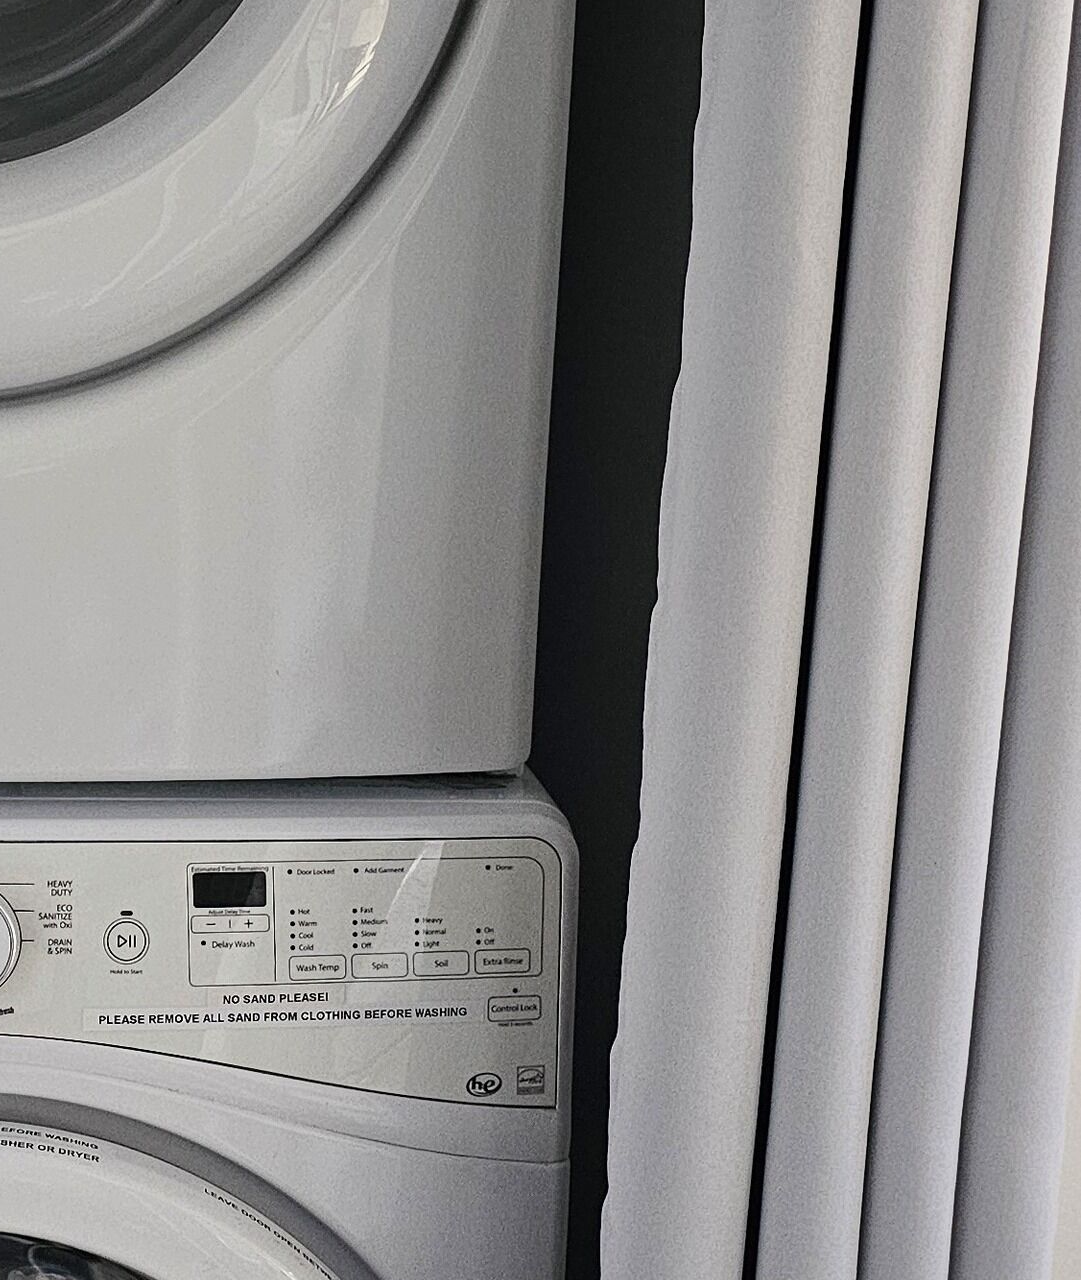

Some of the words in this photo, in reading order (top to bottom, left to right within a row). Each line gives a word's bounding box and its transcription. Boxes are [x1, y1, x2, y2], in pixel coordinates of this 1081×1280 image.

[237, 865, 269, 873] Remaining
[47, 880, 73, 888] HEAVY
[56, 904, 73, 912] ECO
[38, 912, 72, 920] SANITIZE
[47, 938, 73, 946] DRAIN
[211, 941, 233, 949] Delay
[422, 940, 440, 948] Light
[47, 947, 54, 955] &
[54, 947, 73, 955] SPIN
[434, 960, 449, 968] Soil
[482, 958, 502, 966] Extra
[503, 957, 524, 965] Rinse
[296, 964, 317, 972] Wash
[318, 964, 340, 973] Temp
[371, 962, 389, 971] Spin
[222, 995, 240, 1005] NO
[242, 994, 276, 1004] SAND
[491, 1004, 519, 1013] Control
[520, 1003, 538, 1012] Lock
[98, 1014, 145, 1025] PLEASE
[148, 1014, 200, 1024] REMOVE
[203, 1013, 224, 1023] ALL
[227, 1012, 260, 1022] SAND
[264, 1012, 298, 1021] FROM
[301, 1010, 361, 1021] CLOTHING
[364, 1009, 412, 1019] BEFORE
[414, 1007, 468, 1018] WASHING
[45, 1132, 99, 1150] WASHING
[37, 1143, 55, 1153] OR
[58, 1147, 100, 1163] DRYER
[204, 1187, 238, 1209] LEAVE
[241, 1209, 271, 1232] DOOR
[273, 1230, 301, 1254] OPEN
